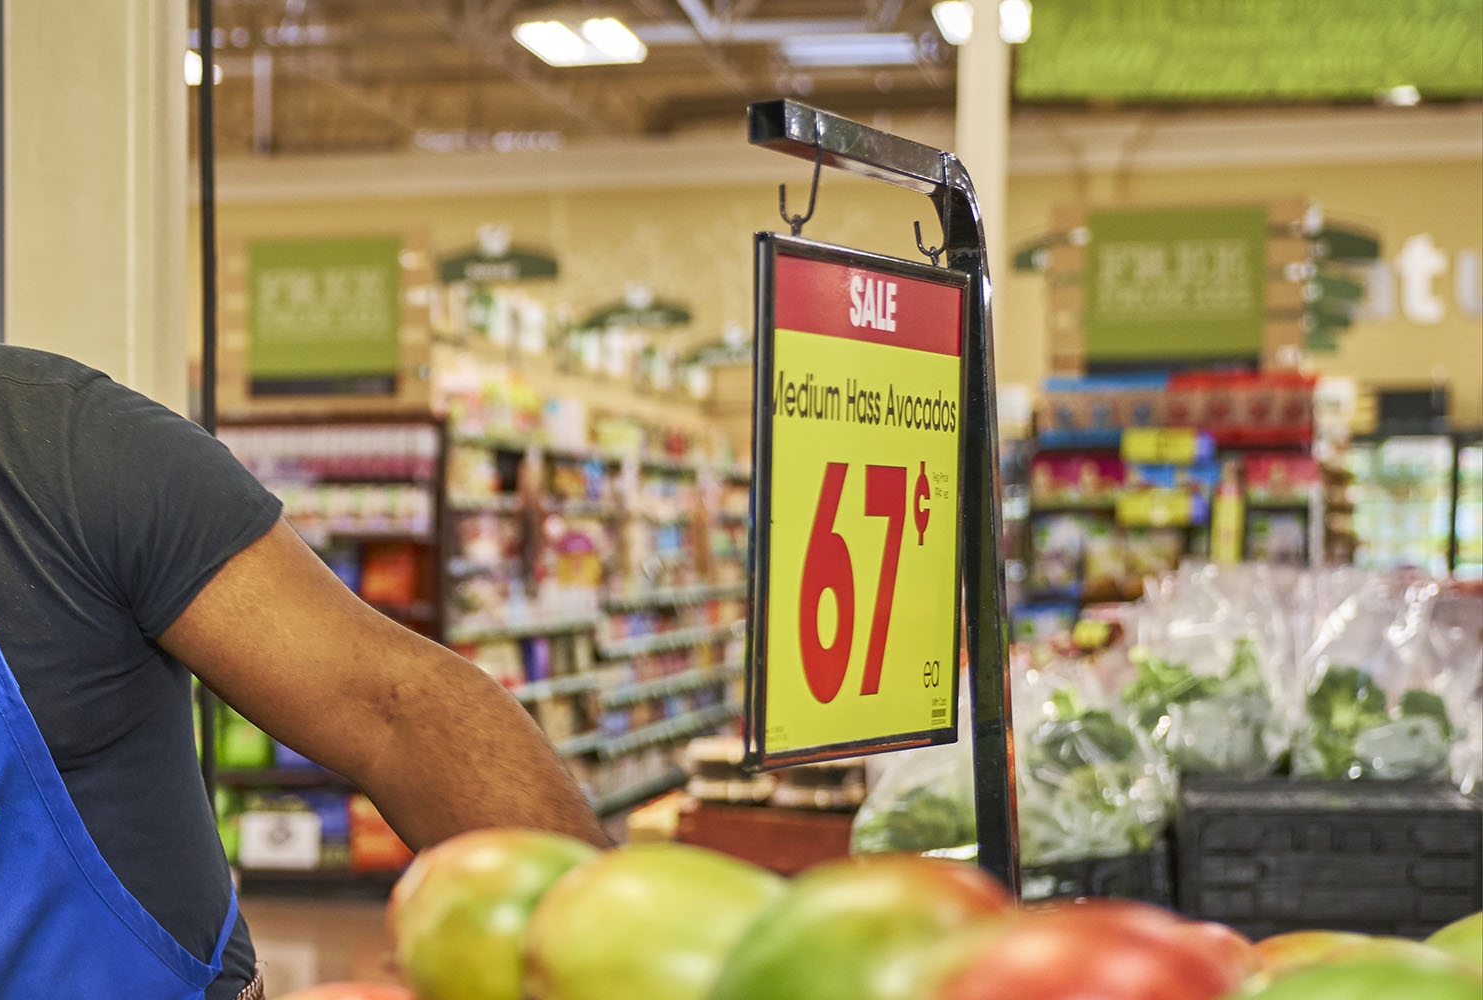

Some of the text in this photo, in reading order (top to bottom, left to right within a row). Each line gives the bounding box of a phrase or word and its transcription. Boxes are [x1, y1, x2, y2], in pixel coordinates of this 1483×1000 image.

[849, 275, 898, 332] SALE
[846, 378, 881, 425] Hass
[884, 383, 957, 433] Avocados
[923, 660, 940, 688] ea
